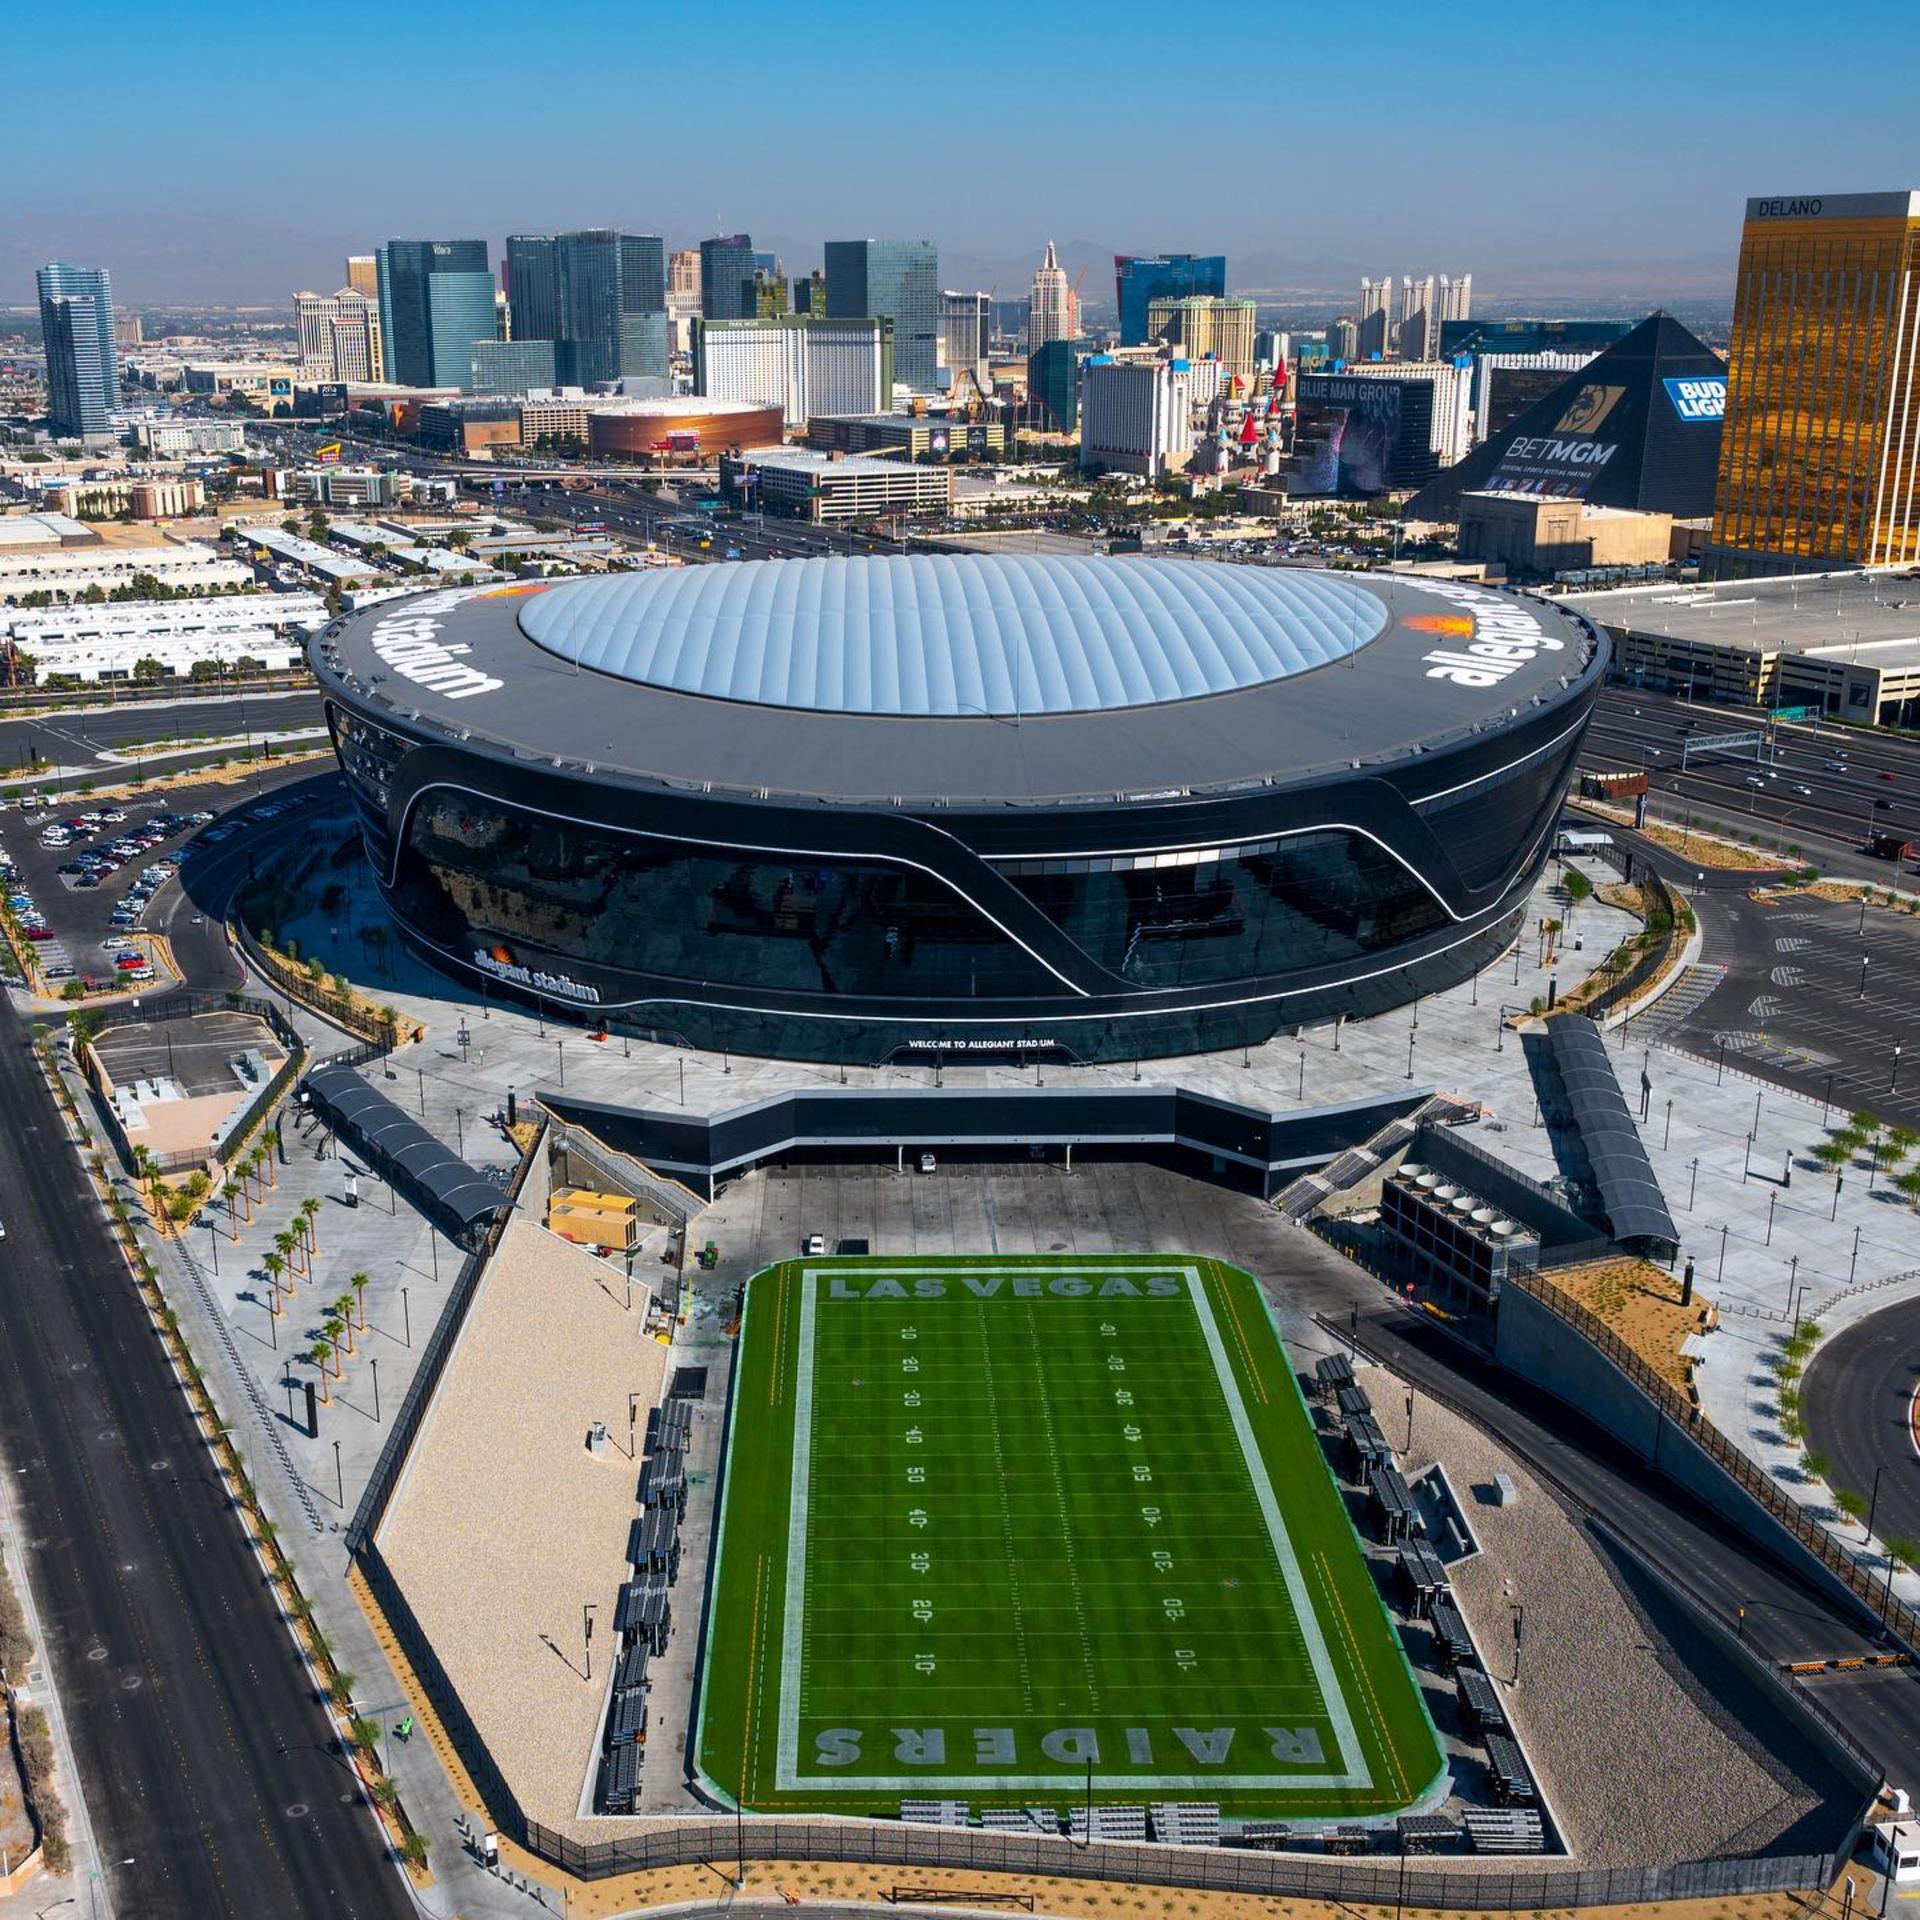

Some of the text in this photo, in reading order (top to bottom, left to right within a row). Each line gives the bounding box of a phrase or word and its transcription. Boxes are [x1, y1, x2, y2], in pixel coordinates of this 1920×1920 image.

[1759, 199, 1822, 216] DELANO
[1299, 381, 1328, 398] BLUE
[1329, 382, 1356, 400] MAN
[1678, 381, 1727, 399] BUD
[1677, 398, 1726, 417] LIGH
[1505, 436, 1618, 465] BETMGM
[371, 617, 505, 699] stadium
[474, 949, 600, 1003] allegiant stadium
[954, 1040, 966, 1048] TO
[968, 1040, 1015, 1048] ALLEGIANT
[1017, 1039, 1055, 1048] STADUM
[830, 1277, 1181, 1298] LAS VEGAS
[901, 1328, 917, 1340] 10
[1100, 1325, 1117, 1336] 10
[902, 1358, 919, 1372] 20
[1107, 1356, 1125, 1371] 20
[904, 1392, 921, 1407] 30
[1115, 1390, 1134, 1405] 30
[905, 1428, 923, 1443] 40
[1123, 1426, 1142, 1442] 40
[907, 1466, 926, 1483] 50
[1132, 1465, 1152, 1482] 50
[909, 1508, 928, 1525] 40
[1141, 1507, 1162, 1524] 40
[910, 1552, 930, 1571] 30
[1152, 1551, 1174, 1569] 30
[912, 1600, 933, 1619] 20
[1163, 1599, 1185, 1617] 20
[914, 1653, 936, 1671] 10
[1174, 1650, 1198, 1667] 10
[815, 1727, 1326, 1766] RAIDERS
